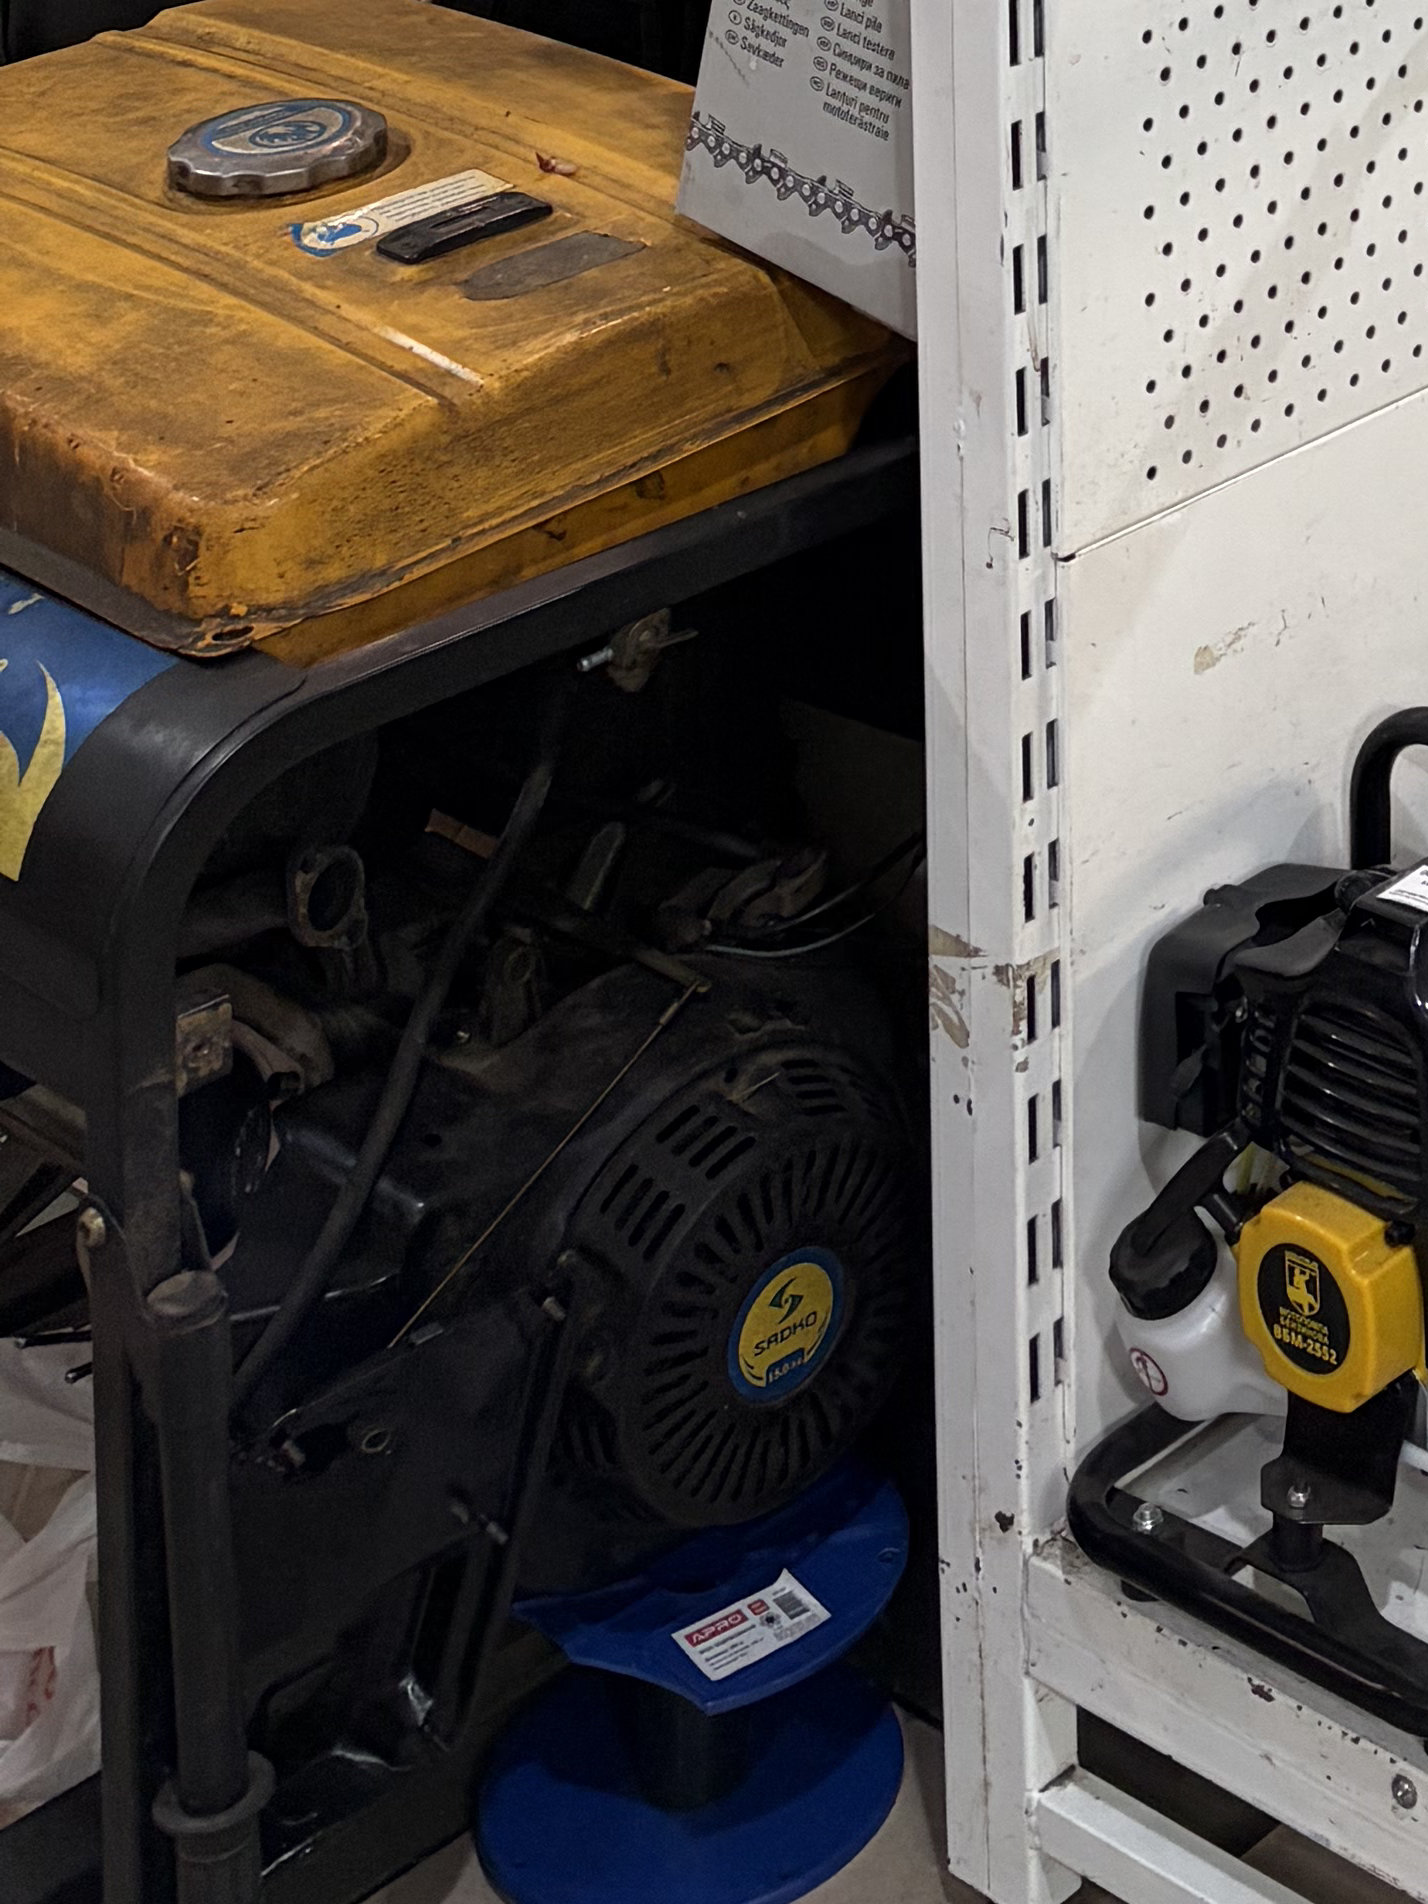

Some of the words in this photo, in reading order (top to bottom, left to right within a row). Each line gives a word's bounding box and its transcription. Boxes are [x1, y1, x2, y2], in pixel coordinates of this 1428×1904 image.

[863, 36, 896, 61] testera
[858, 97, 890, 125] pentru
[753, 1310, 818, 1357] SADKO
[691, 1613, 743, 1645] APRO
